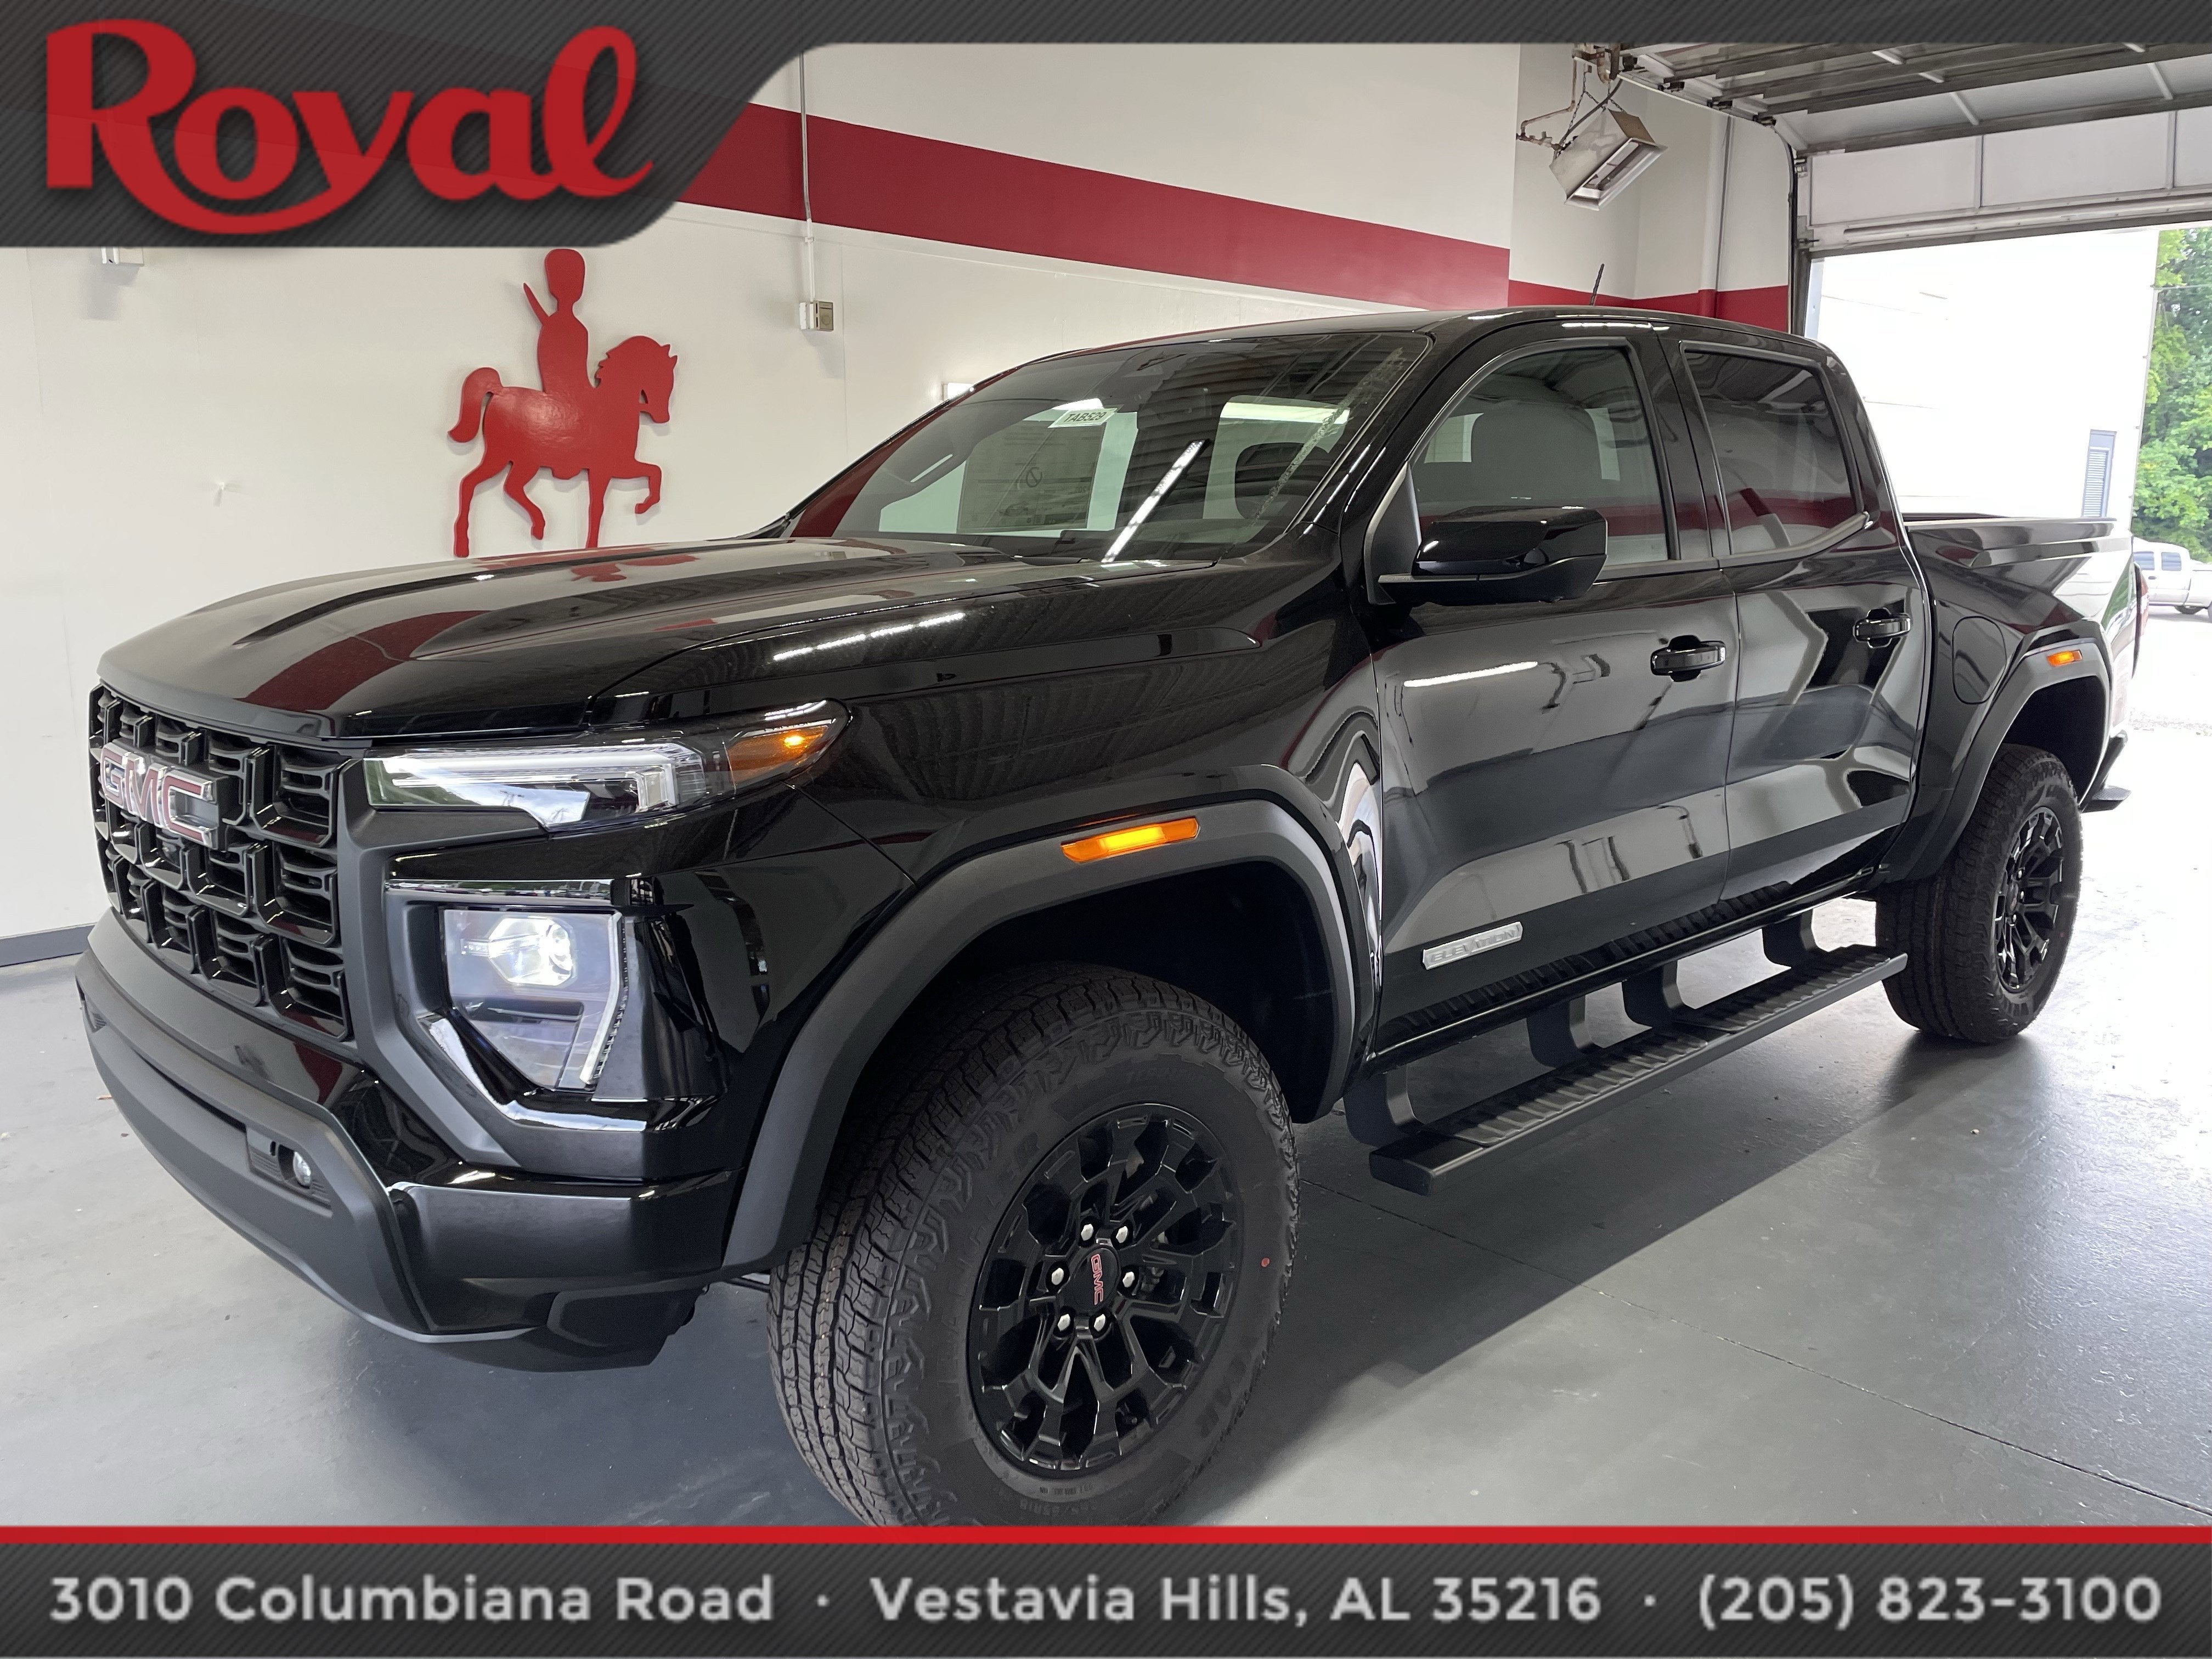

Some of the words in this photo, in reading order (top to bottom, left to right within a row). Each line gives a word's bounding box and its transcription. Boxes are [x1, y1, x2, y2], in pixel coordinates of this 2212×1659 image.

[1064, 411, 1107, 423] TAB529
[100, 742, 216, 849] GMC
[1430, 928, 1516, 963] ELEVATION
[1091, 1254, 1104, 1305] GMC
